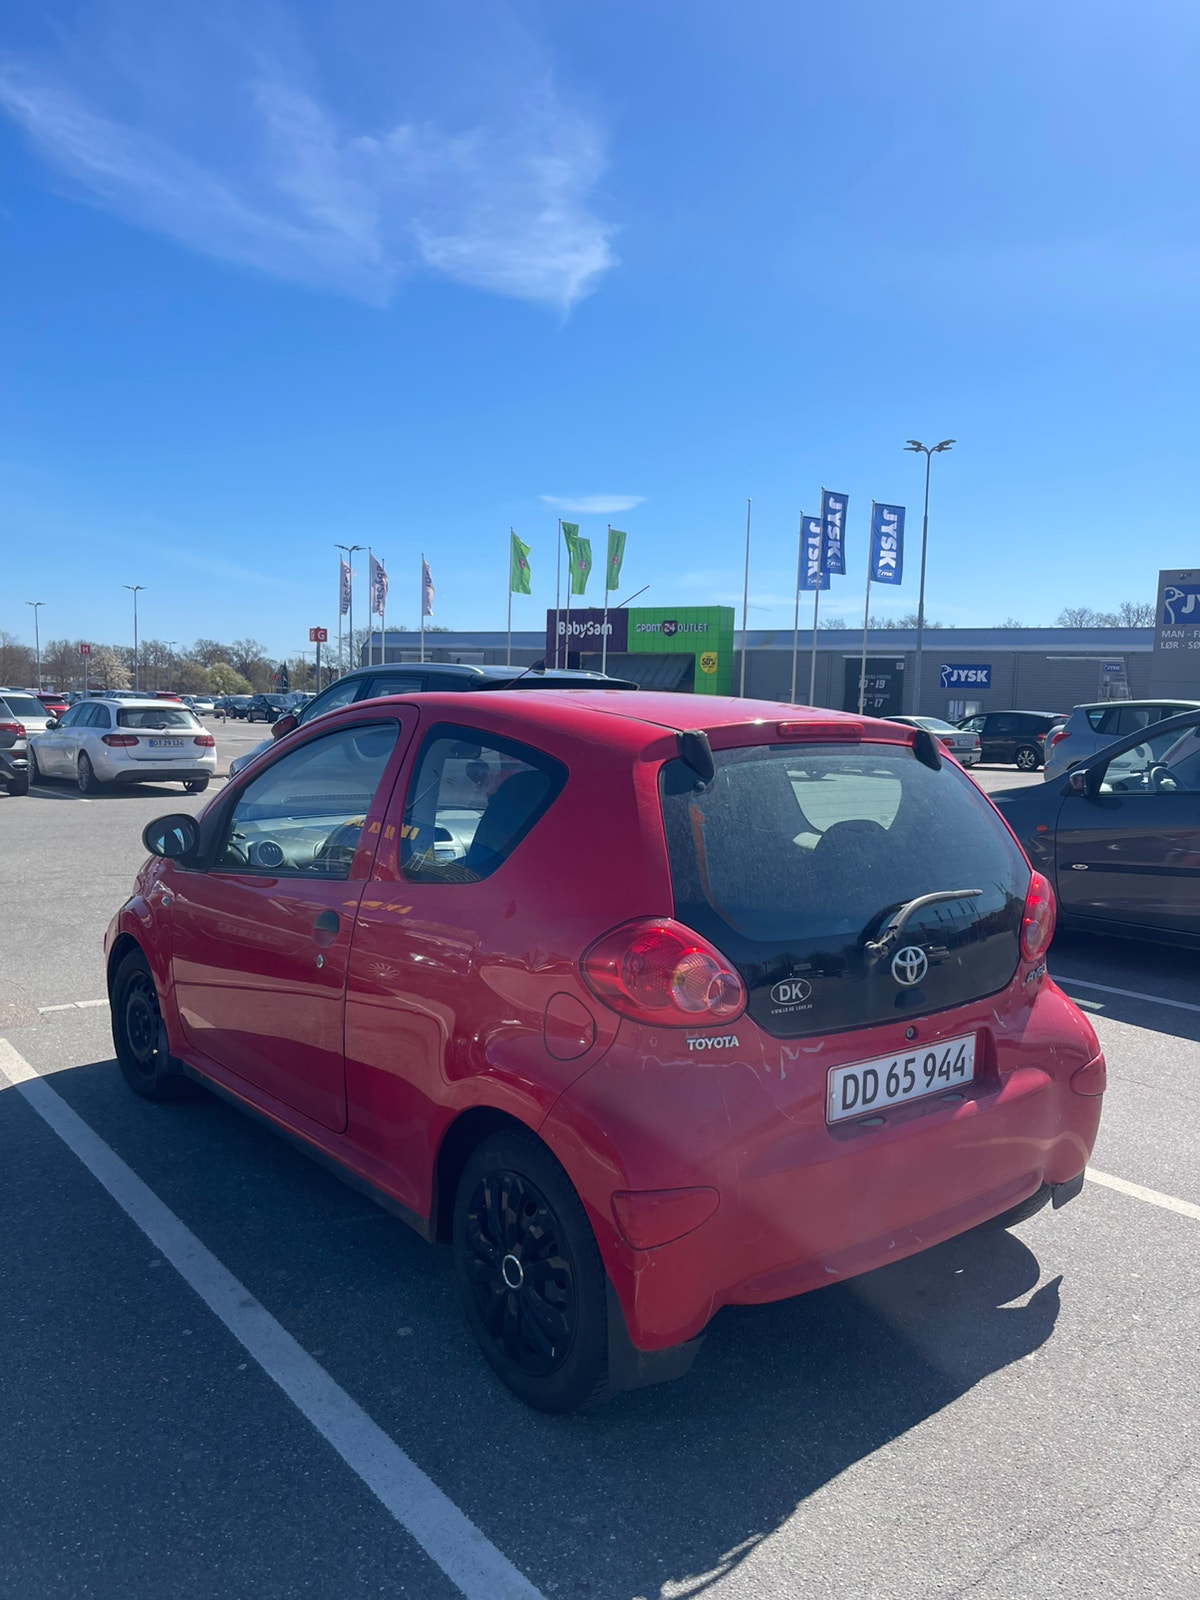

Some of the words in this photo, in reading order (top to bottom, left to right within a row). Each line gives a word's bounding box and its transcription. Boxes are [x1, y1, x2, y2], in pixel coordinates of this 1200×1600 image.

[827, 497, 842, 557] JYSK
[878, 509, 898, 568] JYSK
[558, 621, 613, 638] BabySam
[636, 623, 661, 632] SPORT
[664, 623, 675, 632] 24
[678, 623, 708, 632] OUTLET
[1162, 630, 1184, 638] MAN
[318, 630, 324, 640] G
[951, 670, 988, 682] JYSK
[875, 680, 886, 688] 19
[874, 699, 883, 707] 17
[779, 982, 803, 1001] DK
[687, 1035, 739, 1051] TOYOTA
[842, 1069, 879, 1111] DD
[886, 1057, 916, 1098] 65
[923, 1044, 966, 1088] 944
